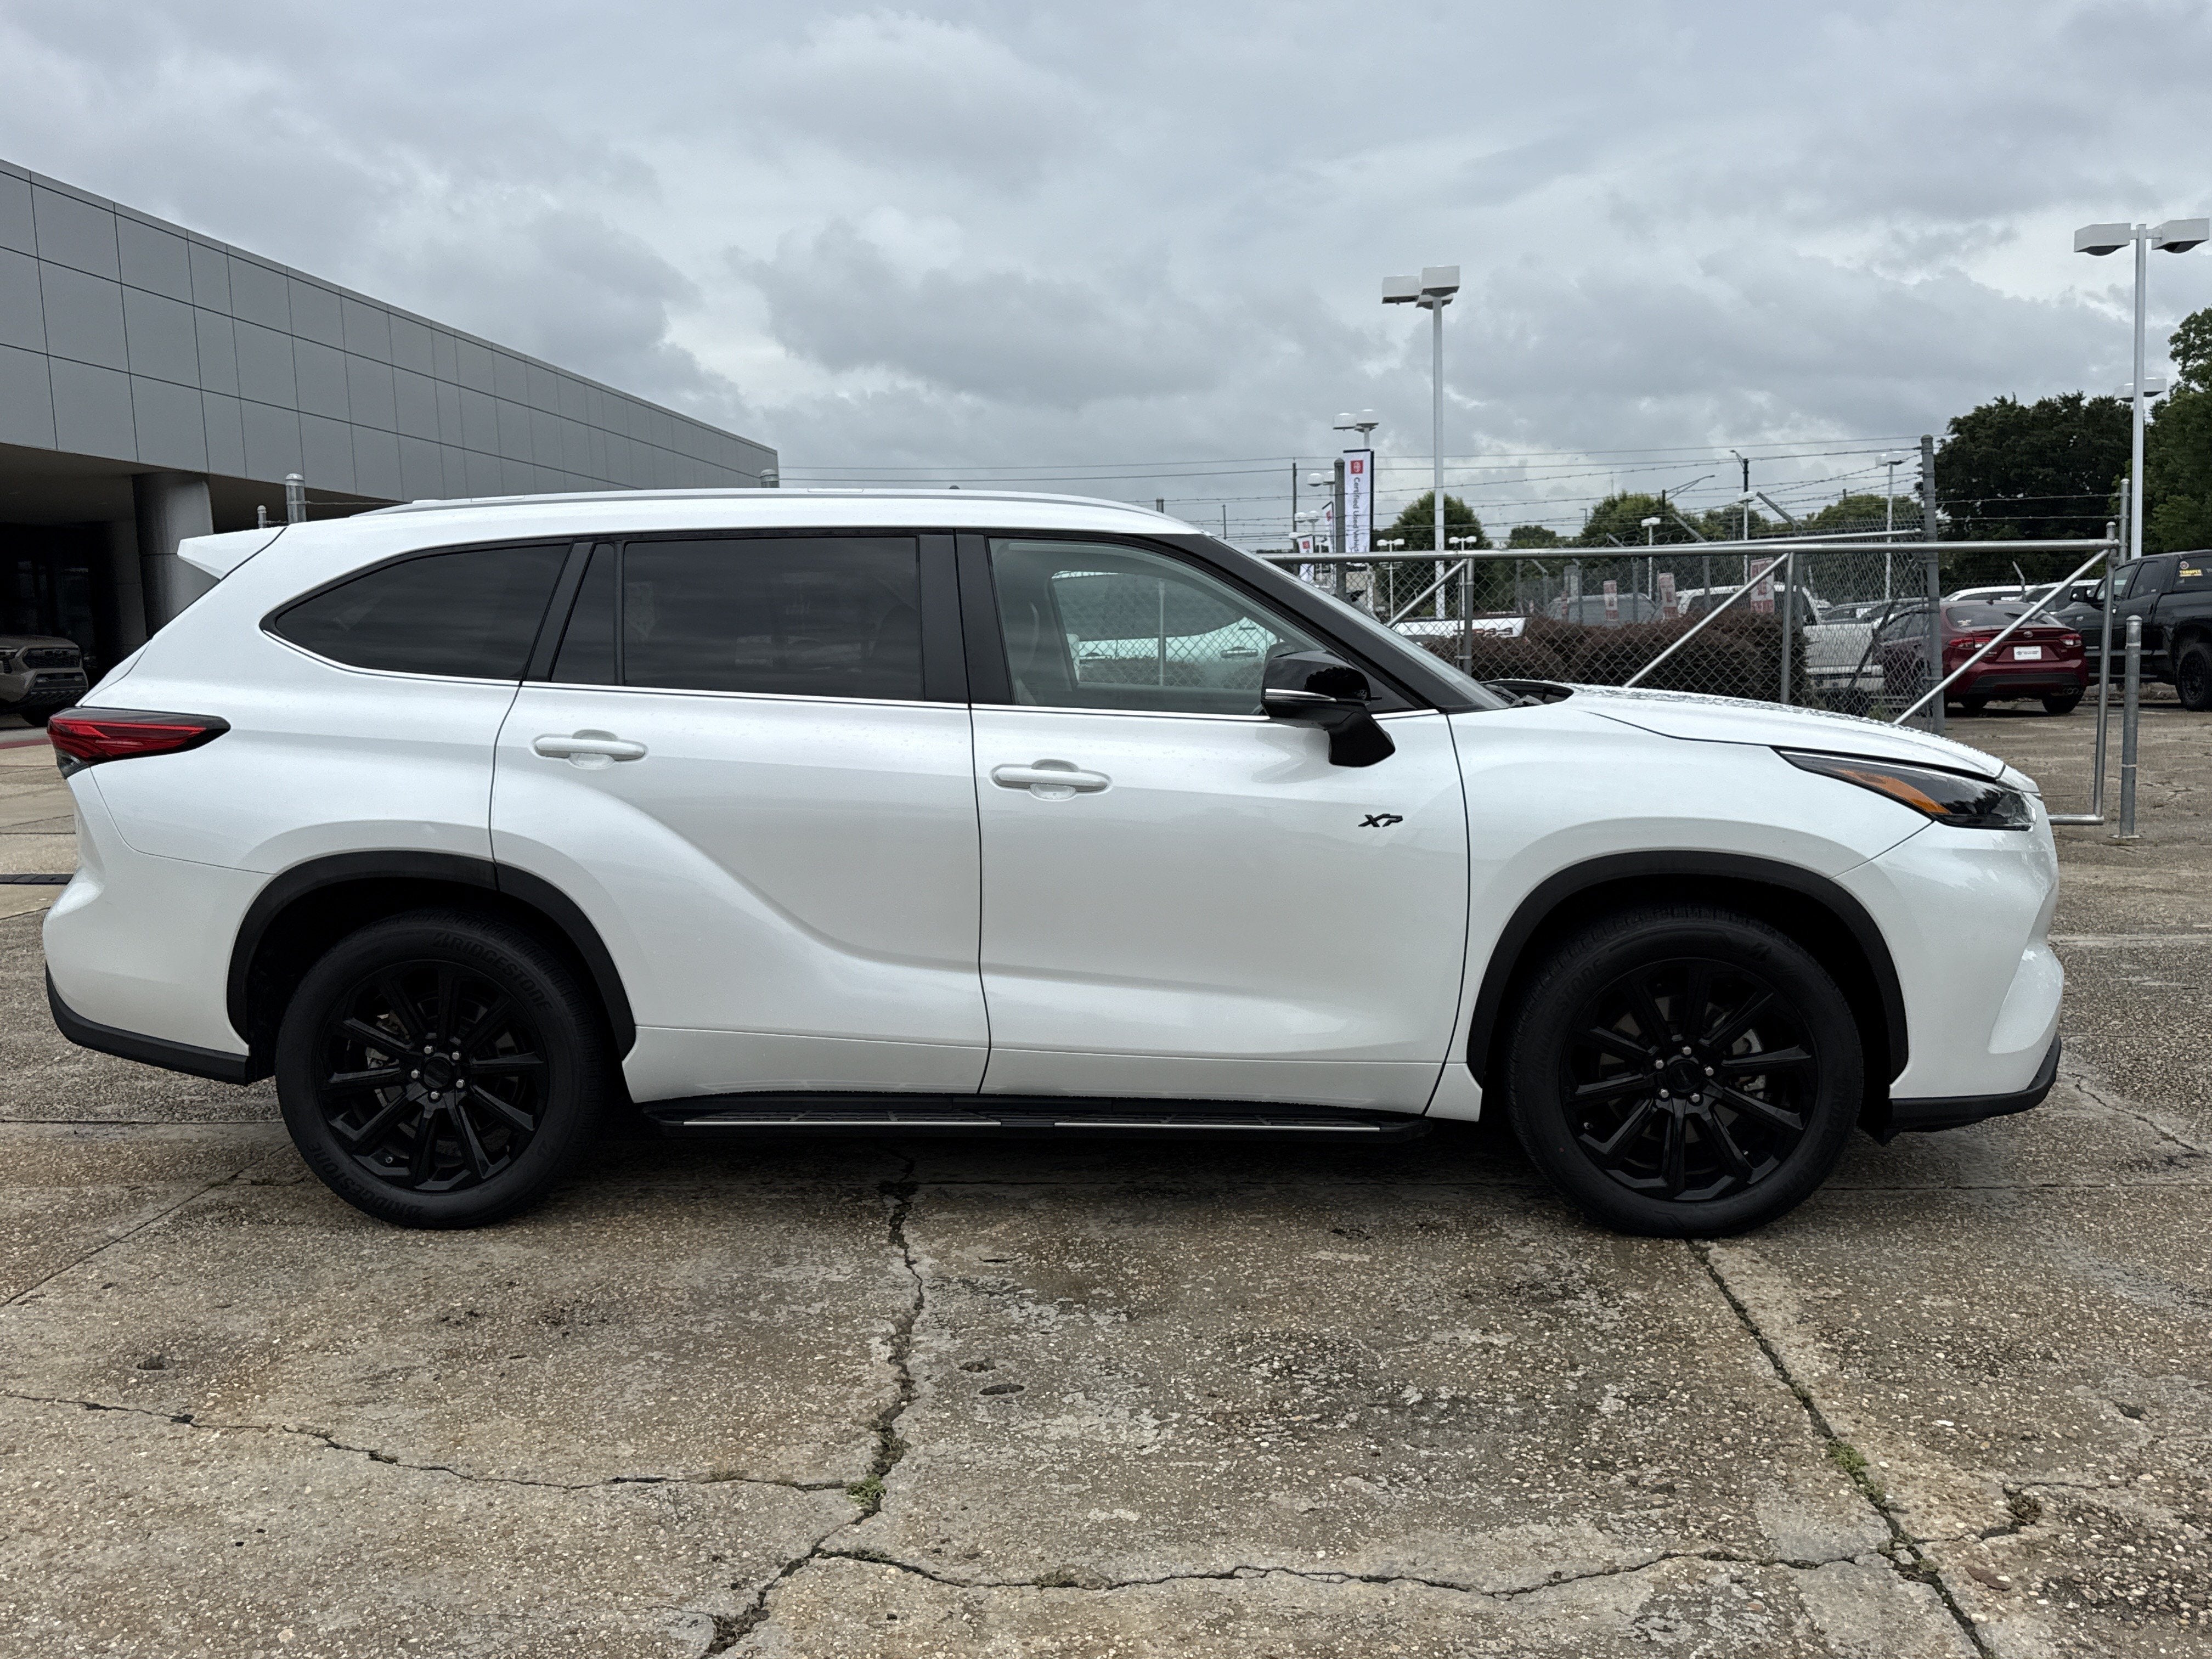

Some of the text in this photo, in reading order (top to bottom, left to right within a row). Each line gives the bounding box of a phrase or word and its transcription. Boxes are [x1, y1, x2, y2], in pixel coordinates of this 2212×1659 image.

[1352, 477, 1361, 509] Certified
[1357, 813, 1404, 827] XP
[432, 932, 554, 1013] BRIDGESTONE
